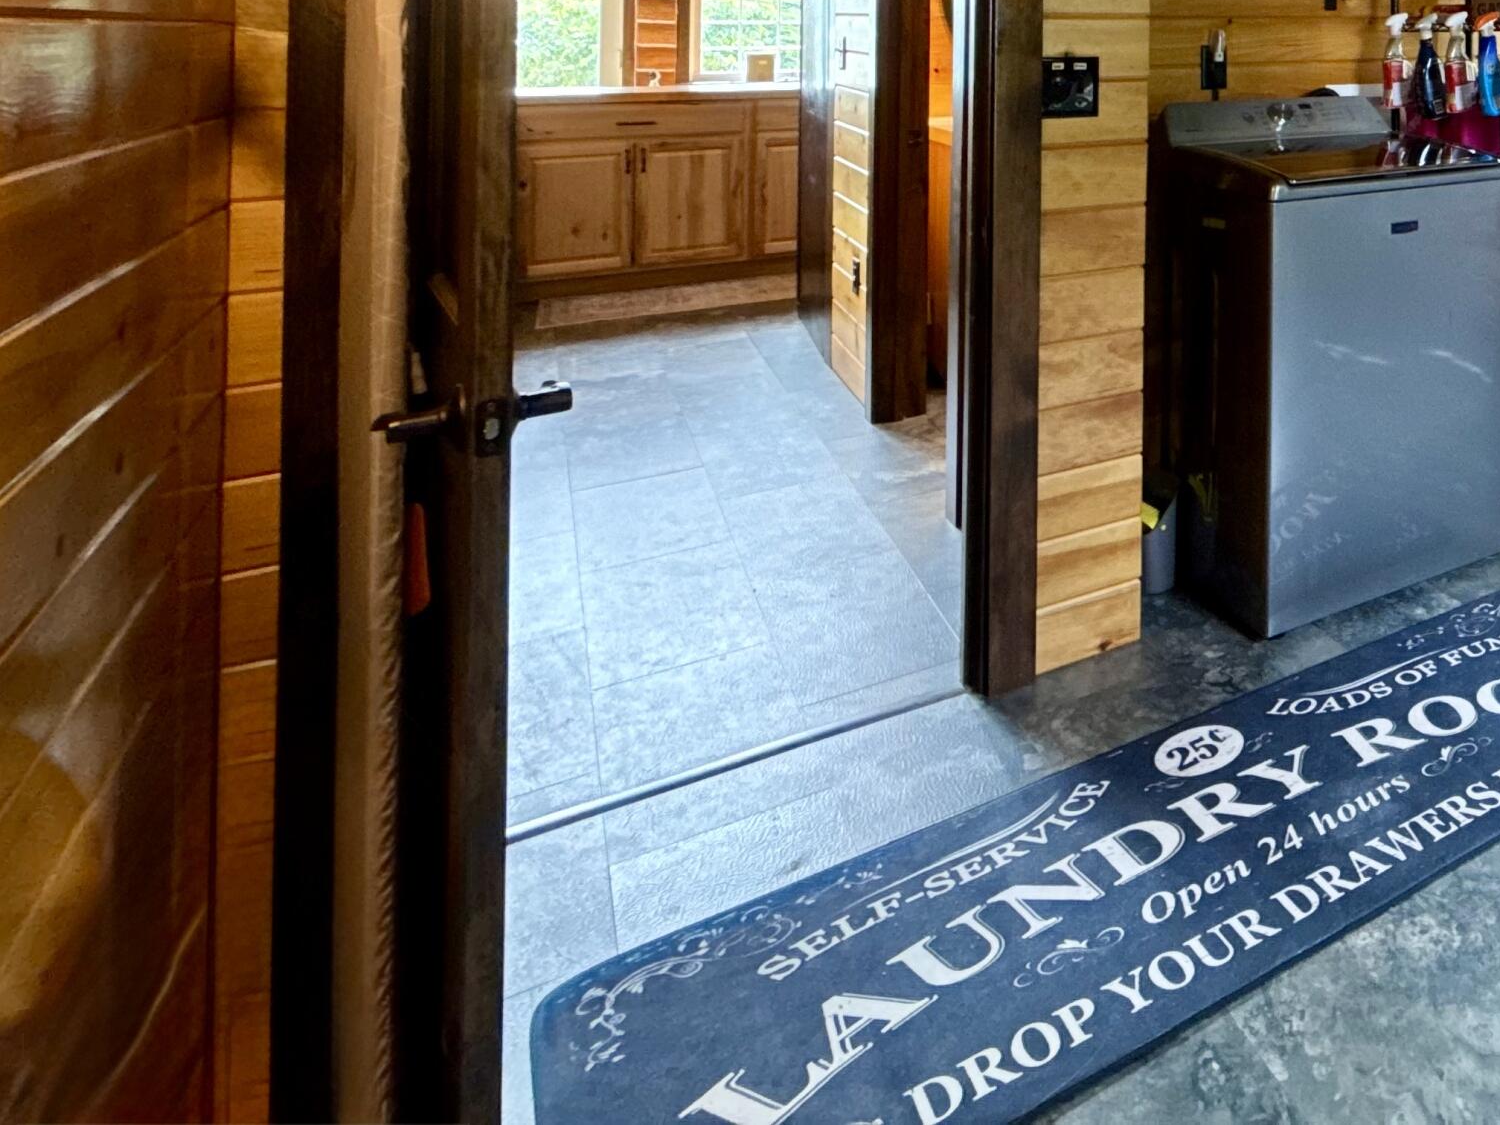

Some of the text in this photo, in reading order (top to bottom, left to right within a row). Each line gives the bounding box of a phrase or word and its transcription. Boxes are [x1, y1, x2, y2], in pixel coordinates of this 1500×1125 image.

[1266, 682, 1393, 716] LOADS
[1394, 660, 1437, 686] OF
[677, 744, 1322, 1125] LAUNDRY
[756, 780, 1111, 981] SELF-SERVICE
[1141, 777, 1411, 924] Open 24 hours
[902, 997, 1095, 1125] DROP
[1099, 908, 1283, 1014] YOUR
